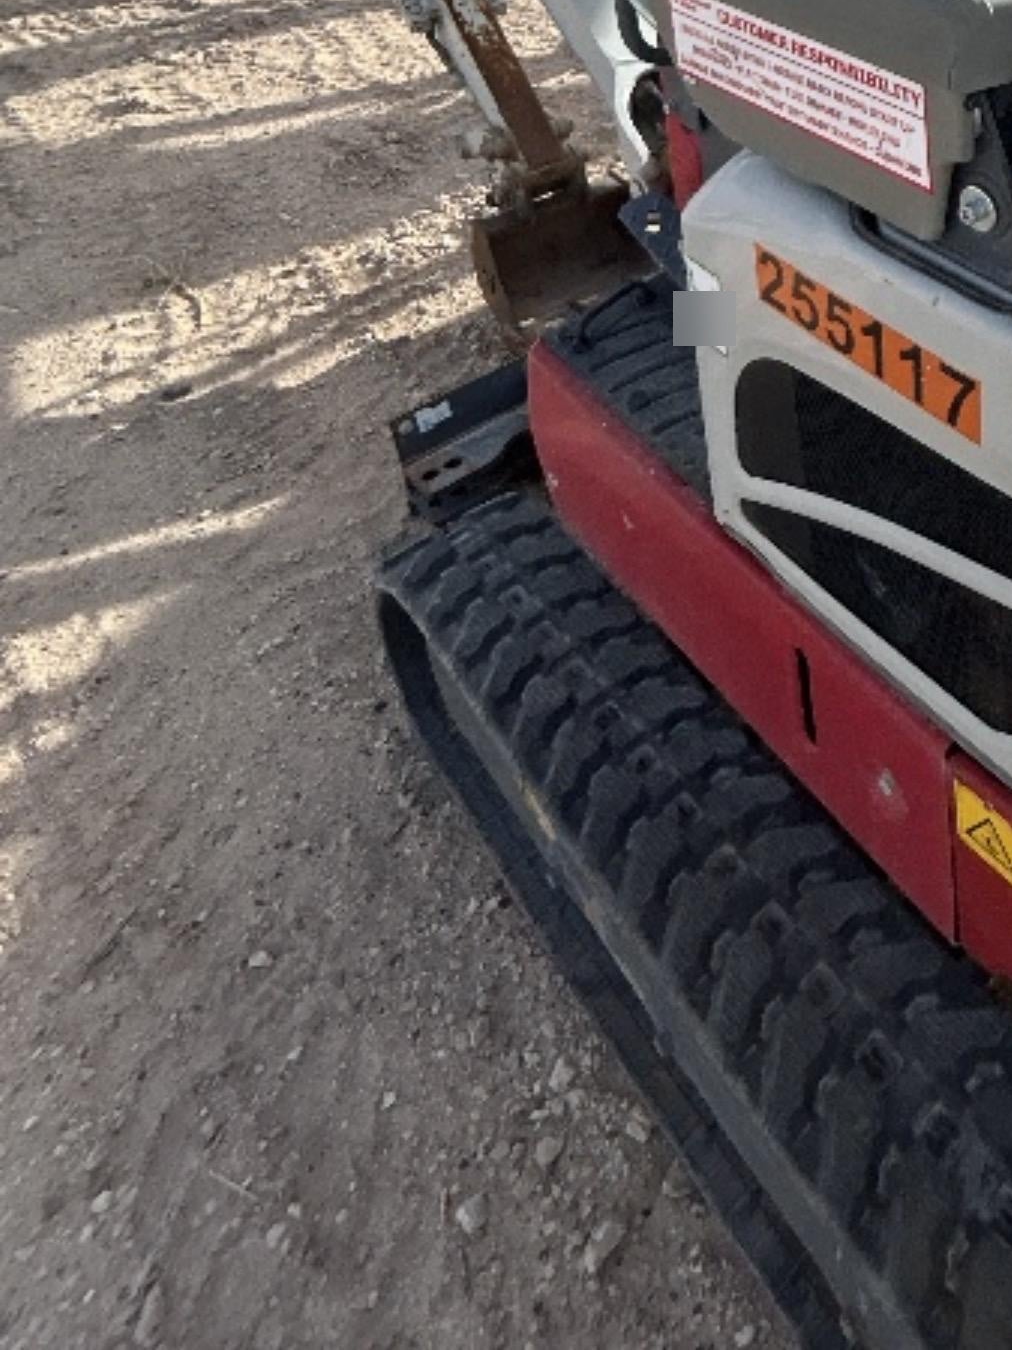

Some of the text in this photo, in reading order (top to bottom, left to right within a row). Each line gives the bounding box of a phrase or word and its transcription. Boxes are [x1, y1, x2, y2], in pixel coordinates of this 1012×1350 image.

[716, 8, 788, 50] CUSTOMER
[791, 37, 922, 108] RESPONSIBILITY
[759, 250, 976, 428] 255117
